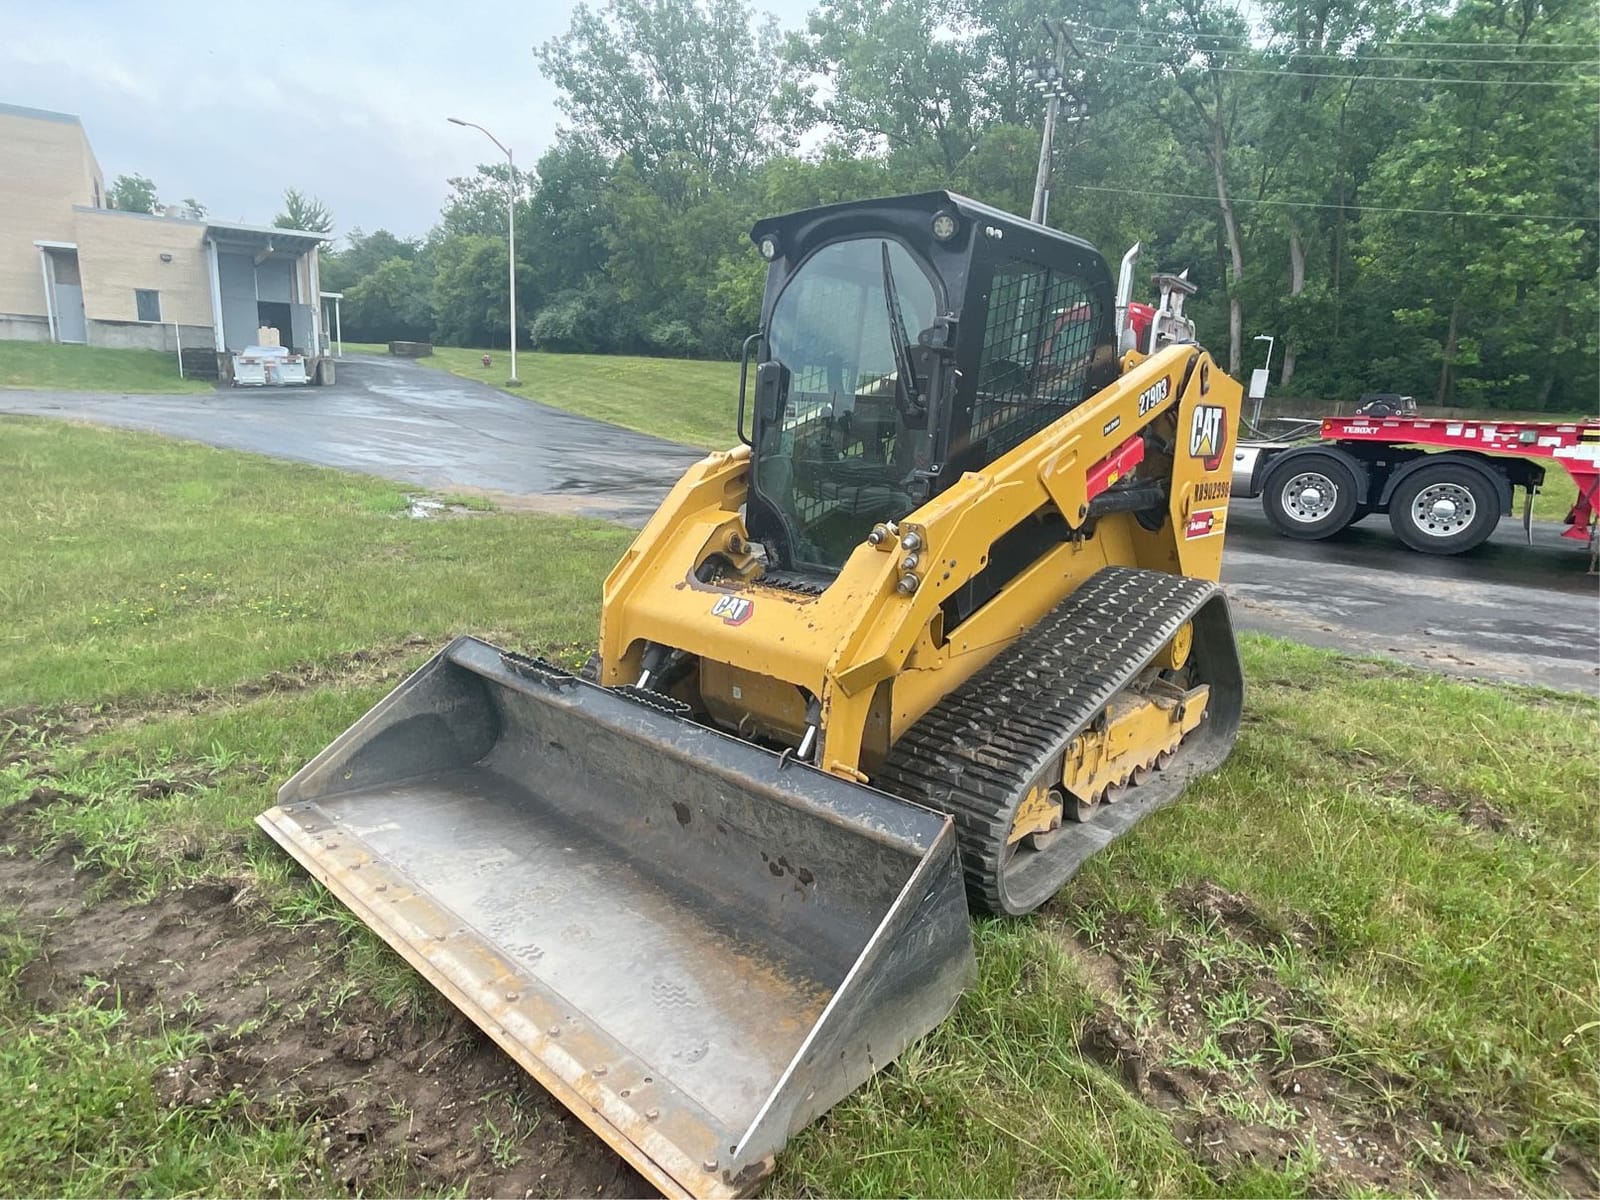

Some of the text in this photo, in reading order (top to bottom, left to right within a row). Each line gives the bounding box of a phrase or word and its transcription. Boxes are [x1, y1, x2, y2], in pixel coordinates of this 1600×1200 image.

[1138, 377, 1168, 417] 279D3
[1189, 405, 1223, 457] CAT
[712, 594, 751, 620] CAT
